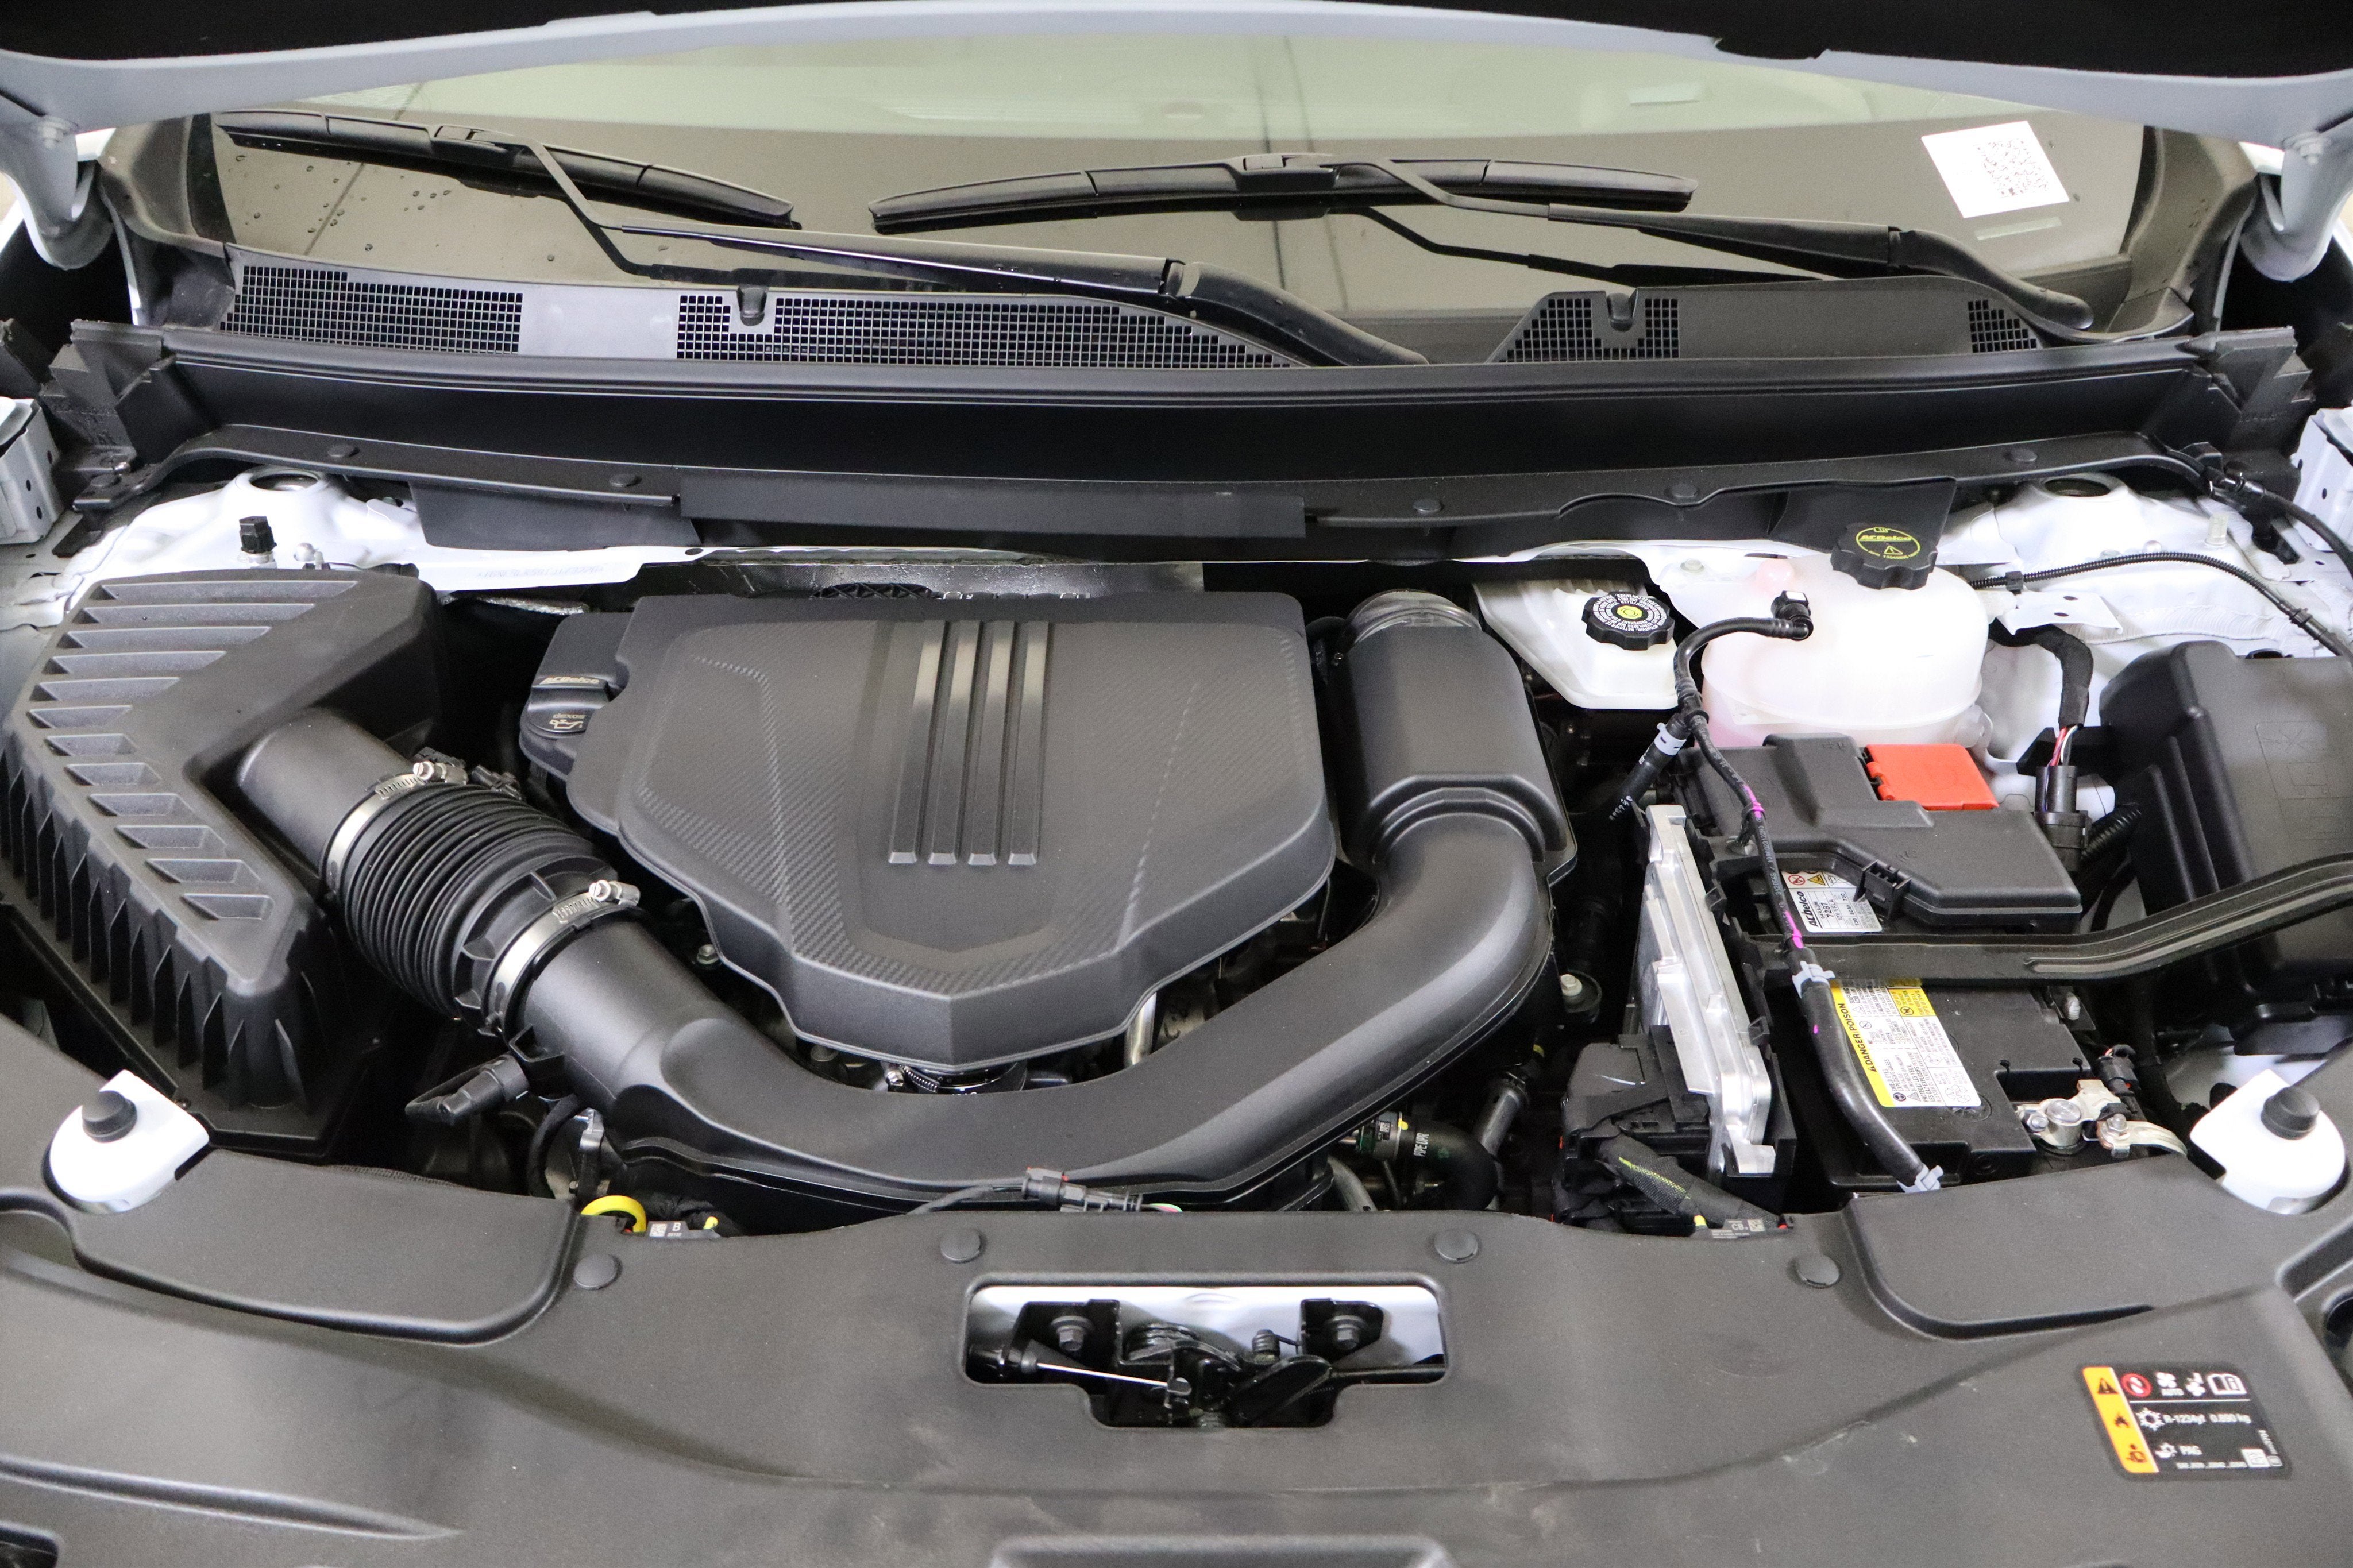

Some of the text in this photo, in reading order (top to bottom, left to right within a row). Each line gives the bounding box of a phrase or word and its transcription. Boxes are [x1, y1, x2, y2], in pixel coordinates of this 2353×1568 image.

[539, 675, 600, 685] ACDelco
[1797, 891, 1818, 927] ACDelco
[1821, 902, 1833, 917] 7287
[1838, 1003, 1873, 1065] DANGER/POISON
[1887, 1079, 1897, 1091] SHIELD
